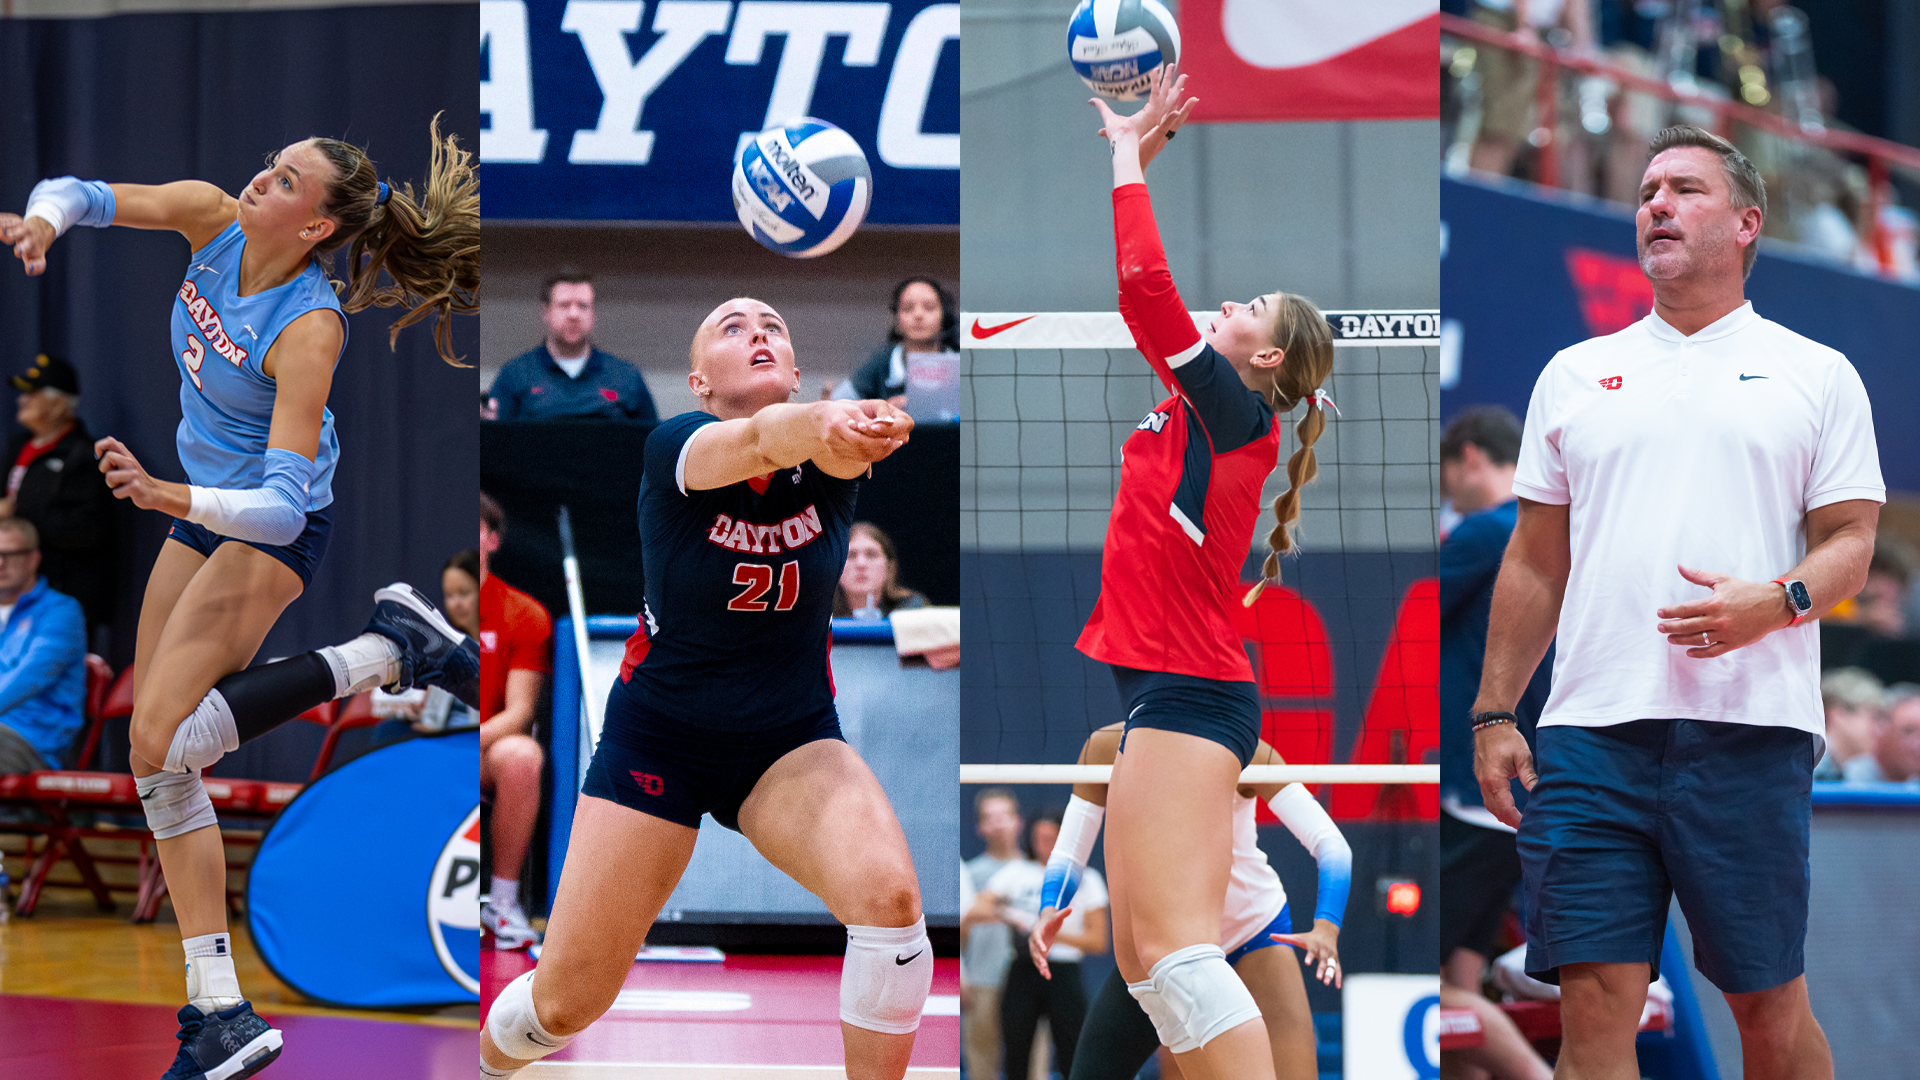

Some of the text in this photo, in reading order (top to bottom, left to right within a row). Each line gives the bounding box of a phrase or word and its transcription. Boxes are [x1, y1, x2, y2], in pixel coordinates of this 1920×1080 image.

[764, 139, 816, 201] molten
[179, 279, 249, 368] DAYTON
[182, 333, 206, 392] 2
[706, 503, 823, 555] DAYTON
[727, 560, 800, 611] 21
[442, 857, 480, 899] P
